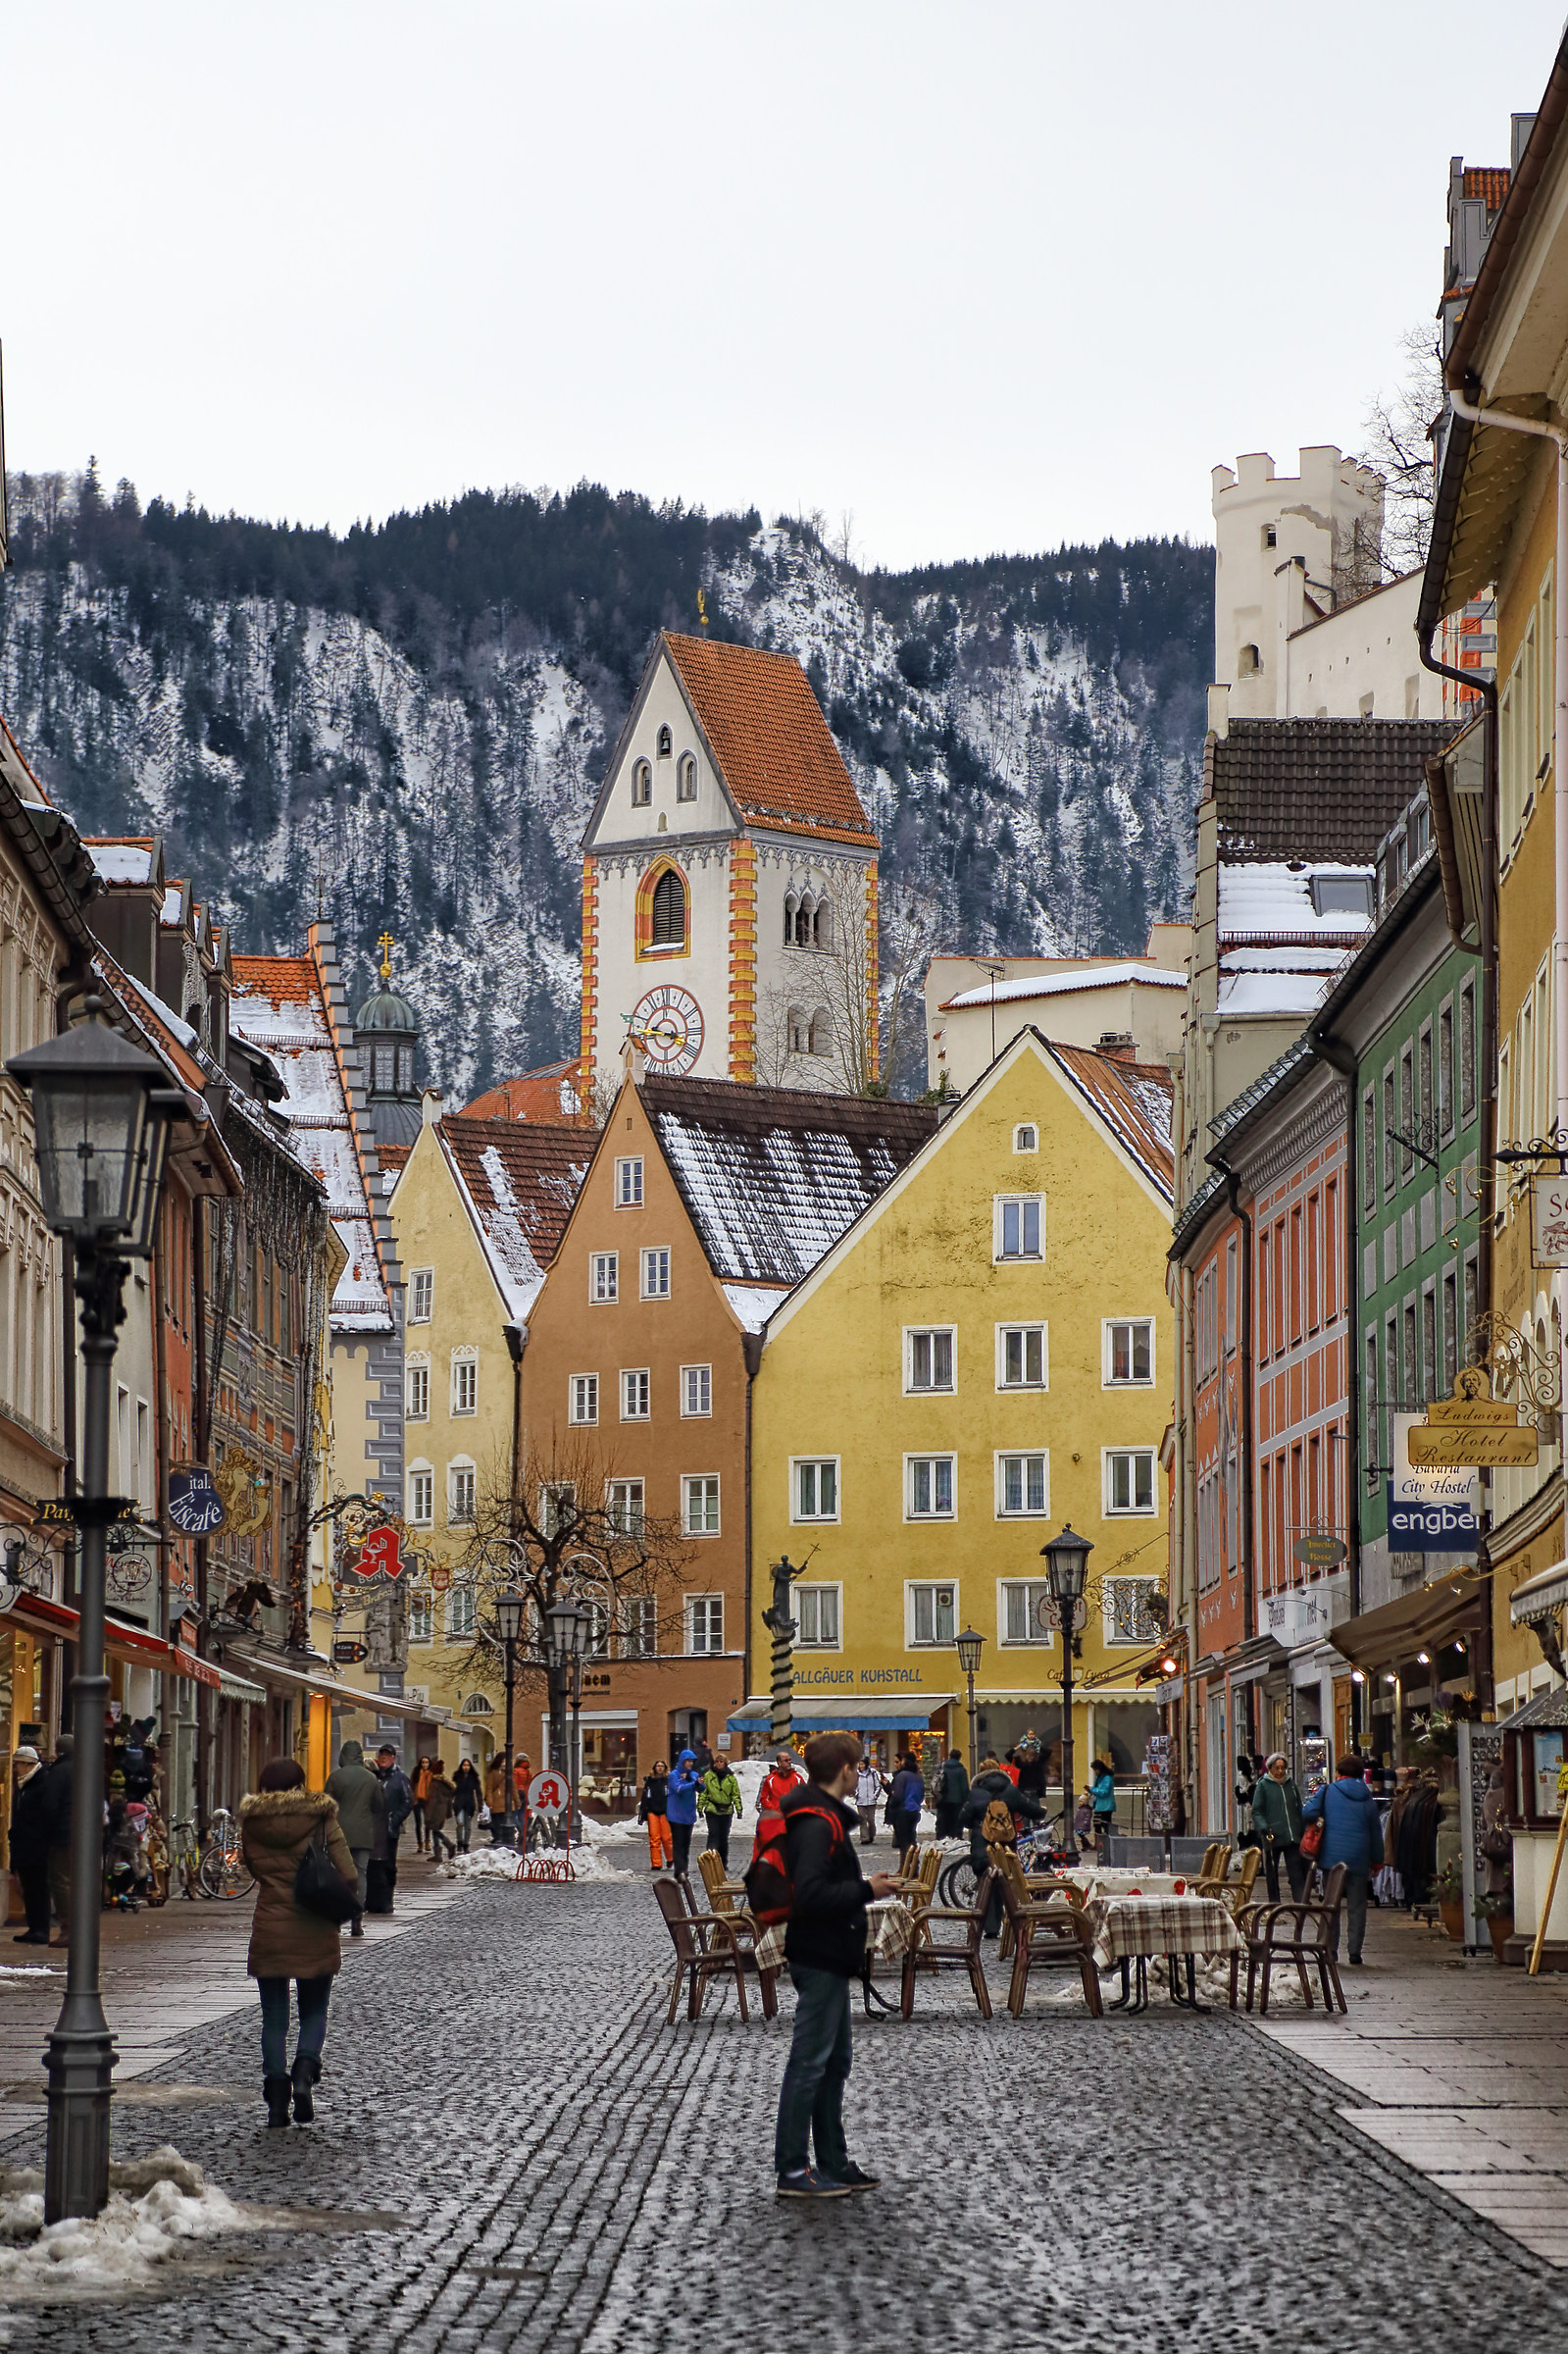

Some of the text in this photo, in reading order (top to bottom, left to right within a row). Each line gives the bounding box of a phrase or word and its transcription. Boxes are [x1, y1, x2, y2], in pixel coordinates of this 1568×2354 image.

[1436, 1406, 1509, 1424] Ludwigs
[1440, 1429, 1508, 1448] Hotel
[1415, 1445, 1533, 1463] Restaurant
[189, 1473, 212, 1490] ital.
[1401, 1475, 1476, 1501] City Hostel
[169, 1491, 223, 1532] Eiscafé
[792, 1667, 923, 1684] ALLGÄUER KUHSTALL
